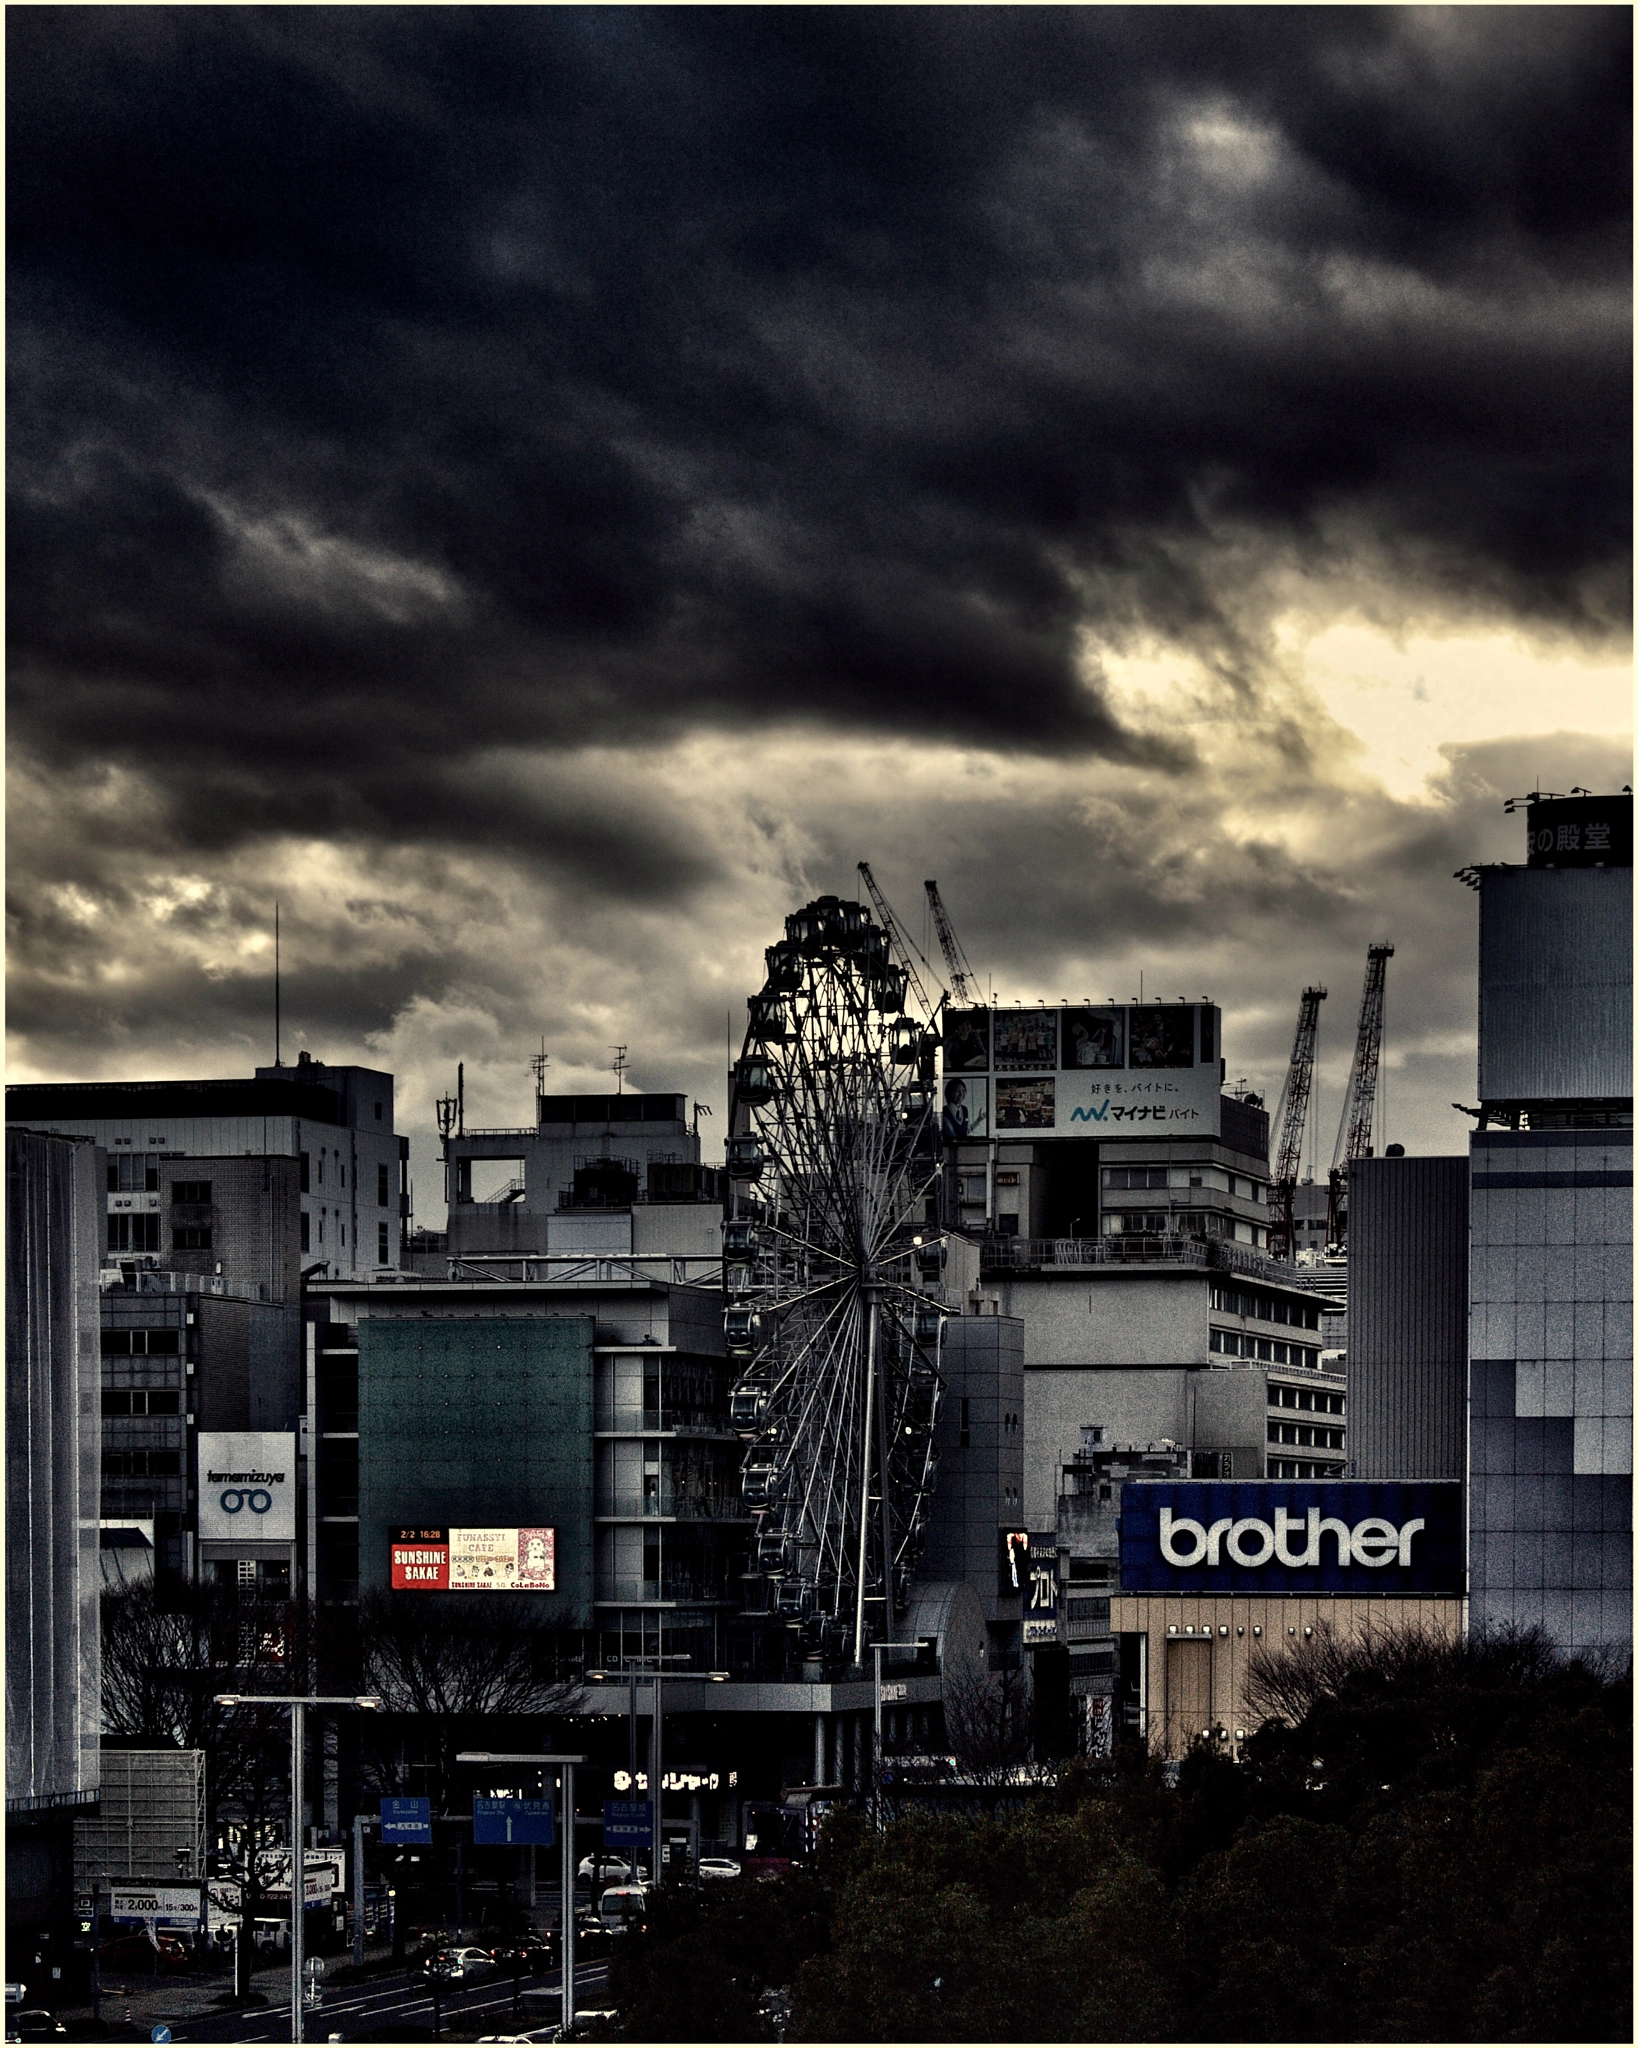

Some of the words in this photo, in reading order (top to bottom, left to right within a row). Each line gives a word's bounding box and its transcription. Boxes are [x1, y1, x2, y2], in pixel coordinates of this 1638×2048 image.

[1091, 1083, 1179, 1094] 好きを、バイトに。
[1110, 1105, 1166, 1121] マイナビ
[1169, 1108, 1199, 1120] バイト
[207, 1469, 285, 1486] tamamizuya
[400, 1530, 415, 1539] 2/2
[420, 1530, 441, 1539] 16:28
[1159, 1506, 1425, 1568] brother
[394, 1550, 446, 1565] SUNSHINE
[405, 1566, 439, 1580] SAKAE
[1029, 1565, 1058, 1609] プロト
